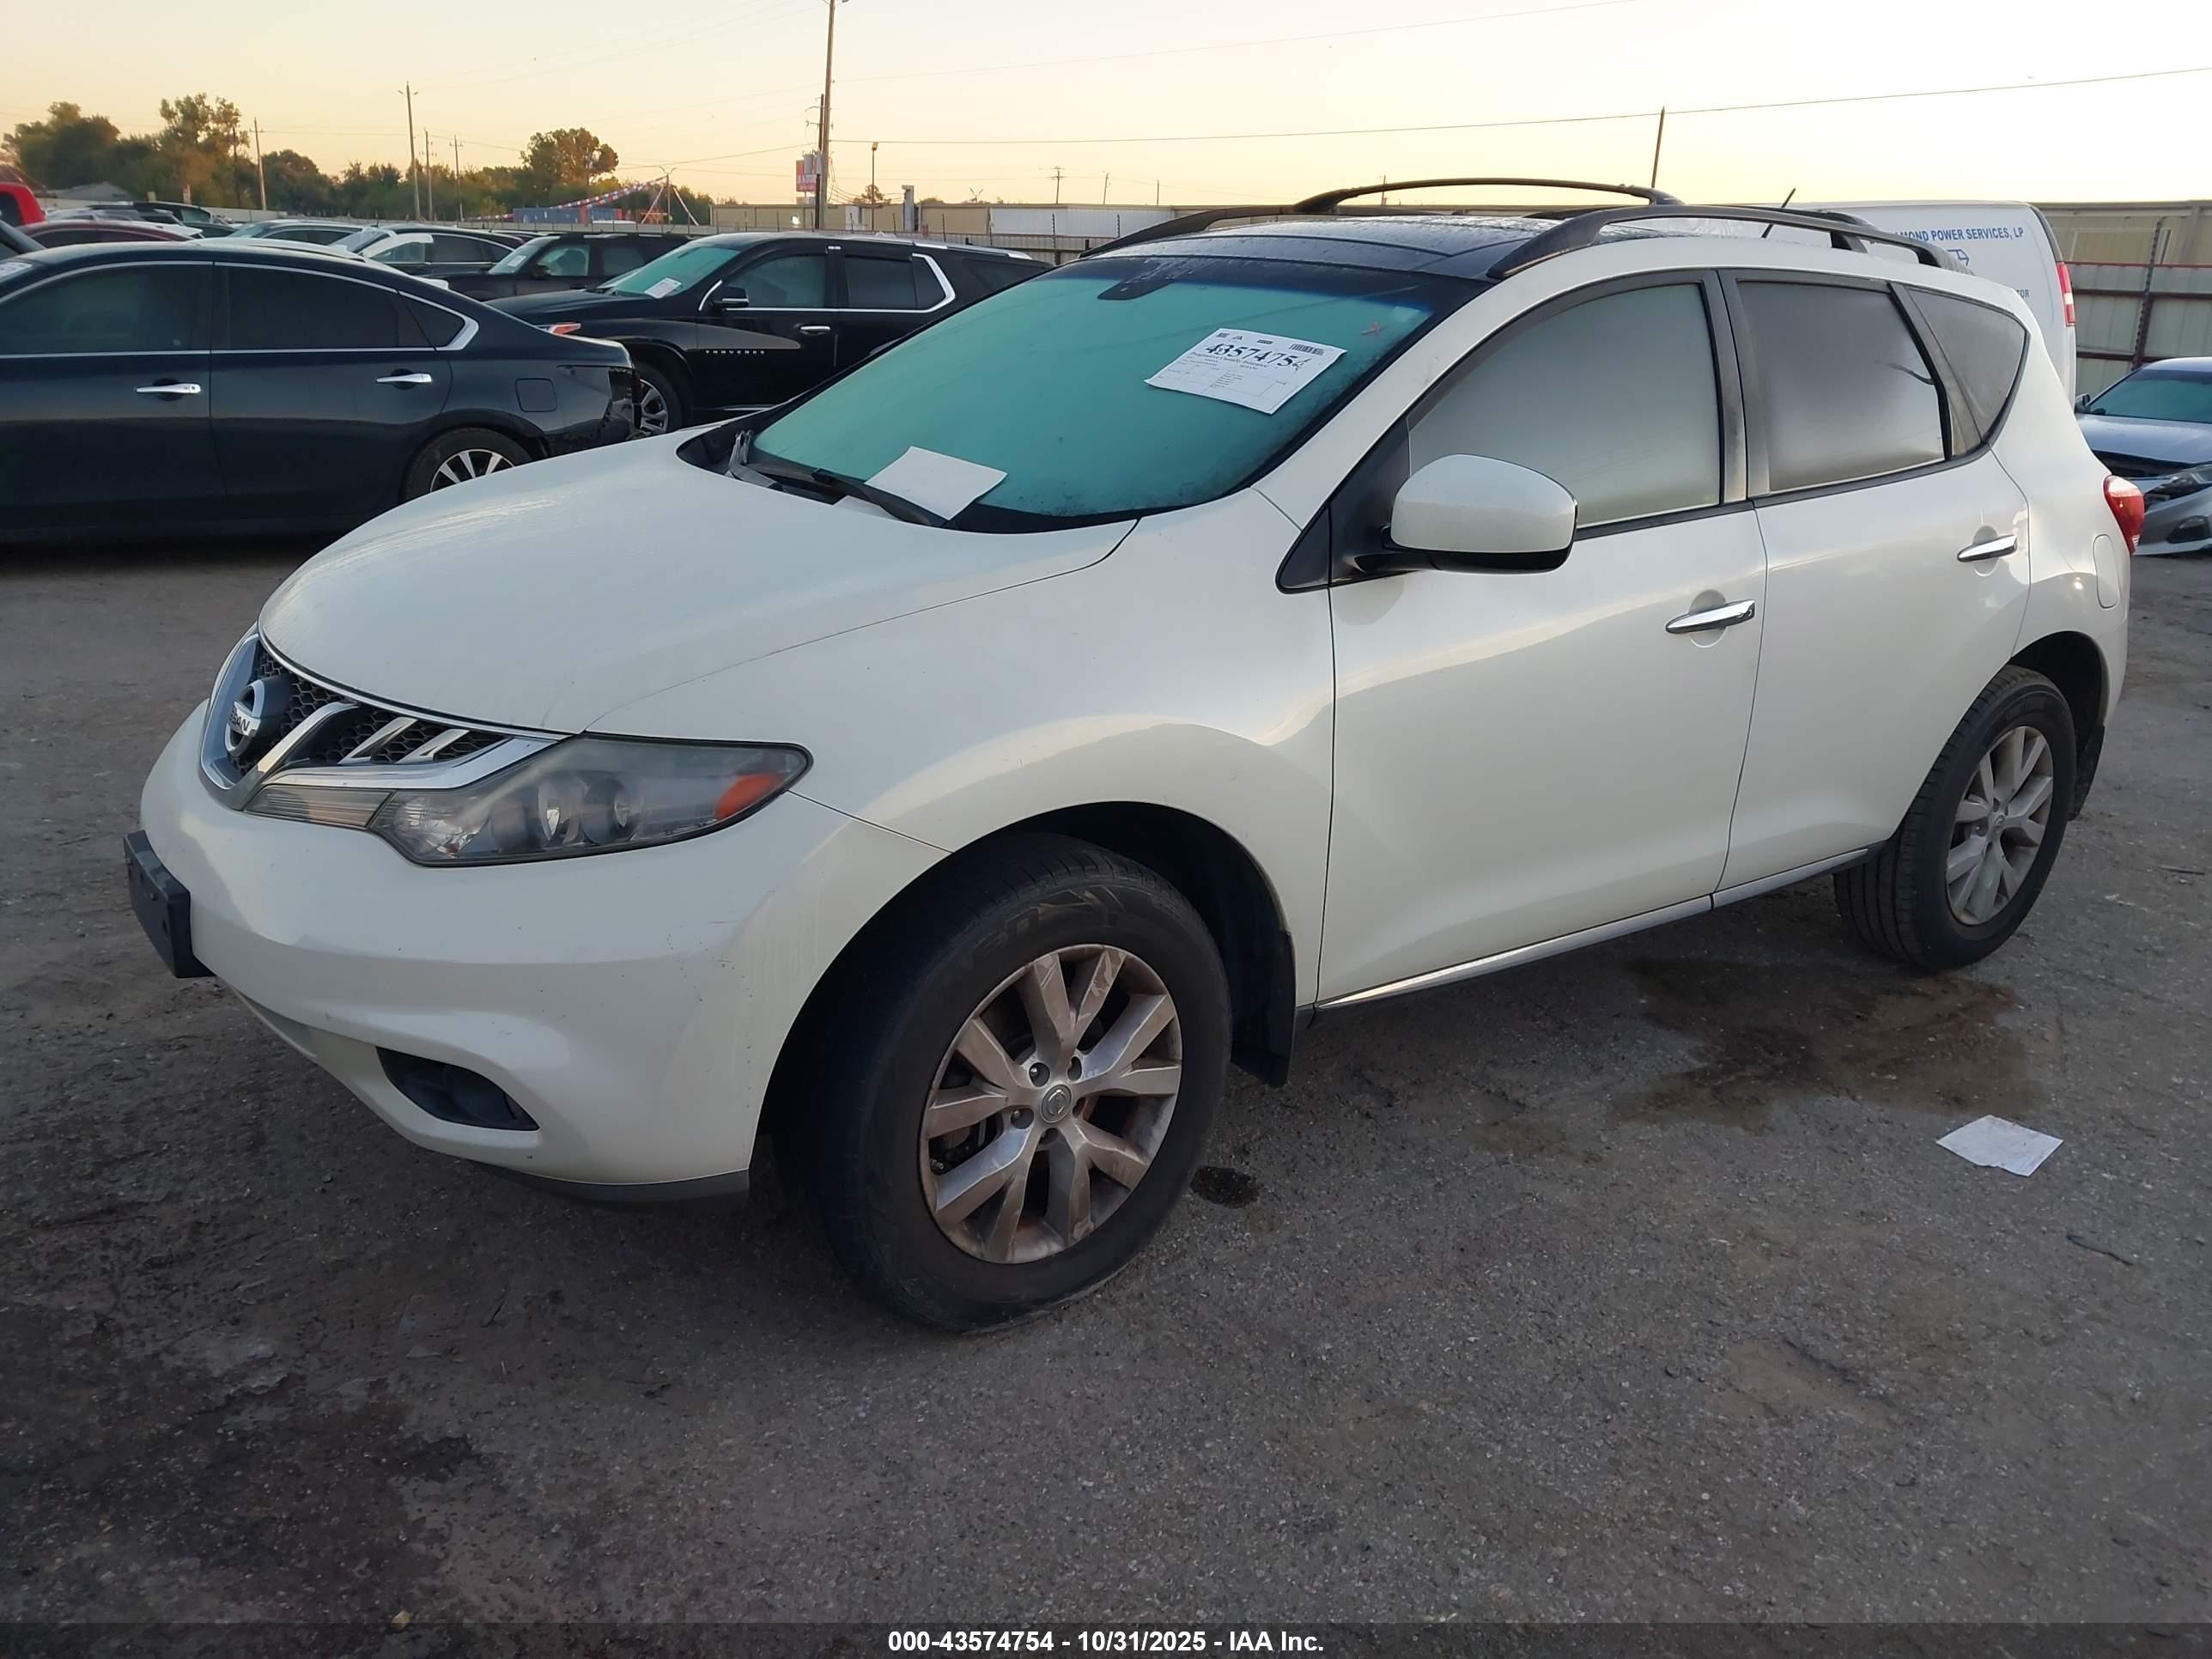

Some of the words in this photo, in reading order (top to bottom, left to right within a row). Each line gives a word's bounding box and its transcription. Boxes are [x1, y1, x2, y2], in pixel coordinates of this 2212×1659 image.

[1930, 229, 1965, 241] POWER
[1966, 227, 2013, 240] SERVICES,
[2013, 227, 2024, 239] LP
